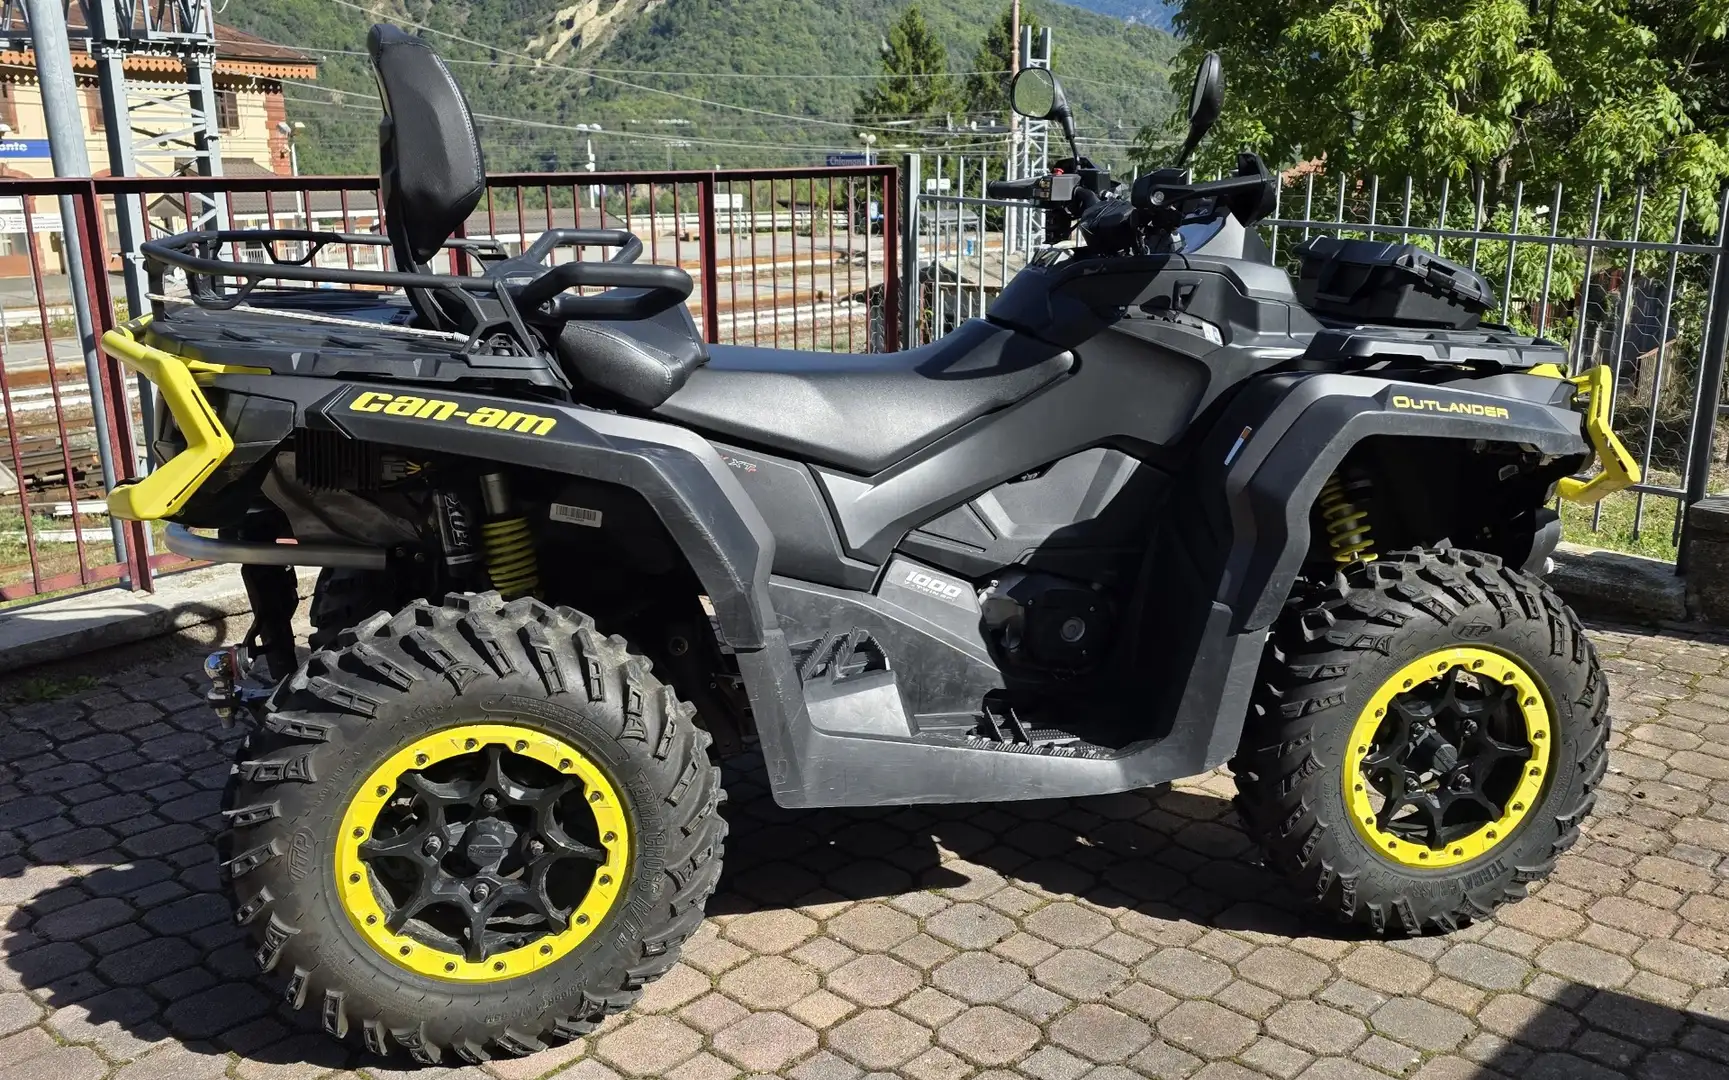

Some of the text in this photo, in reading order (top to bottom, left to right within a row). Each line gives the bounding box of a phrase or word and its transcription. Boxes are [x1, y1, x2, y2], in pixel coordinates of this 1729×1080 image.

[830, 156, 868, 166] Chiomont
[349, 391, 557, 436] can-am
[444, 494, 472, 547] FOX
[905, 571, 962, 598] 1000
[1457, 624, 1493, 637] ITP
[290, 832, 312, 881] ITP
